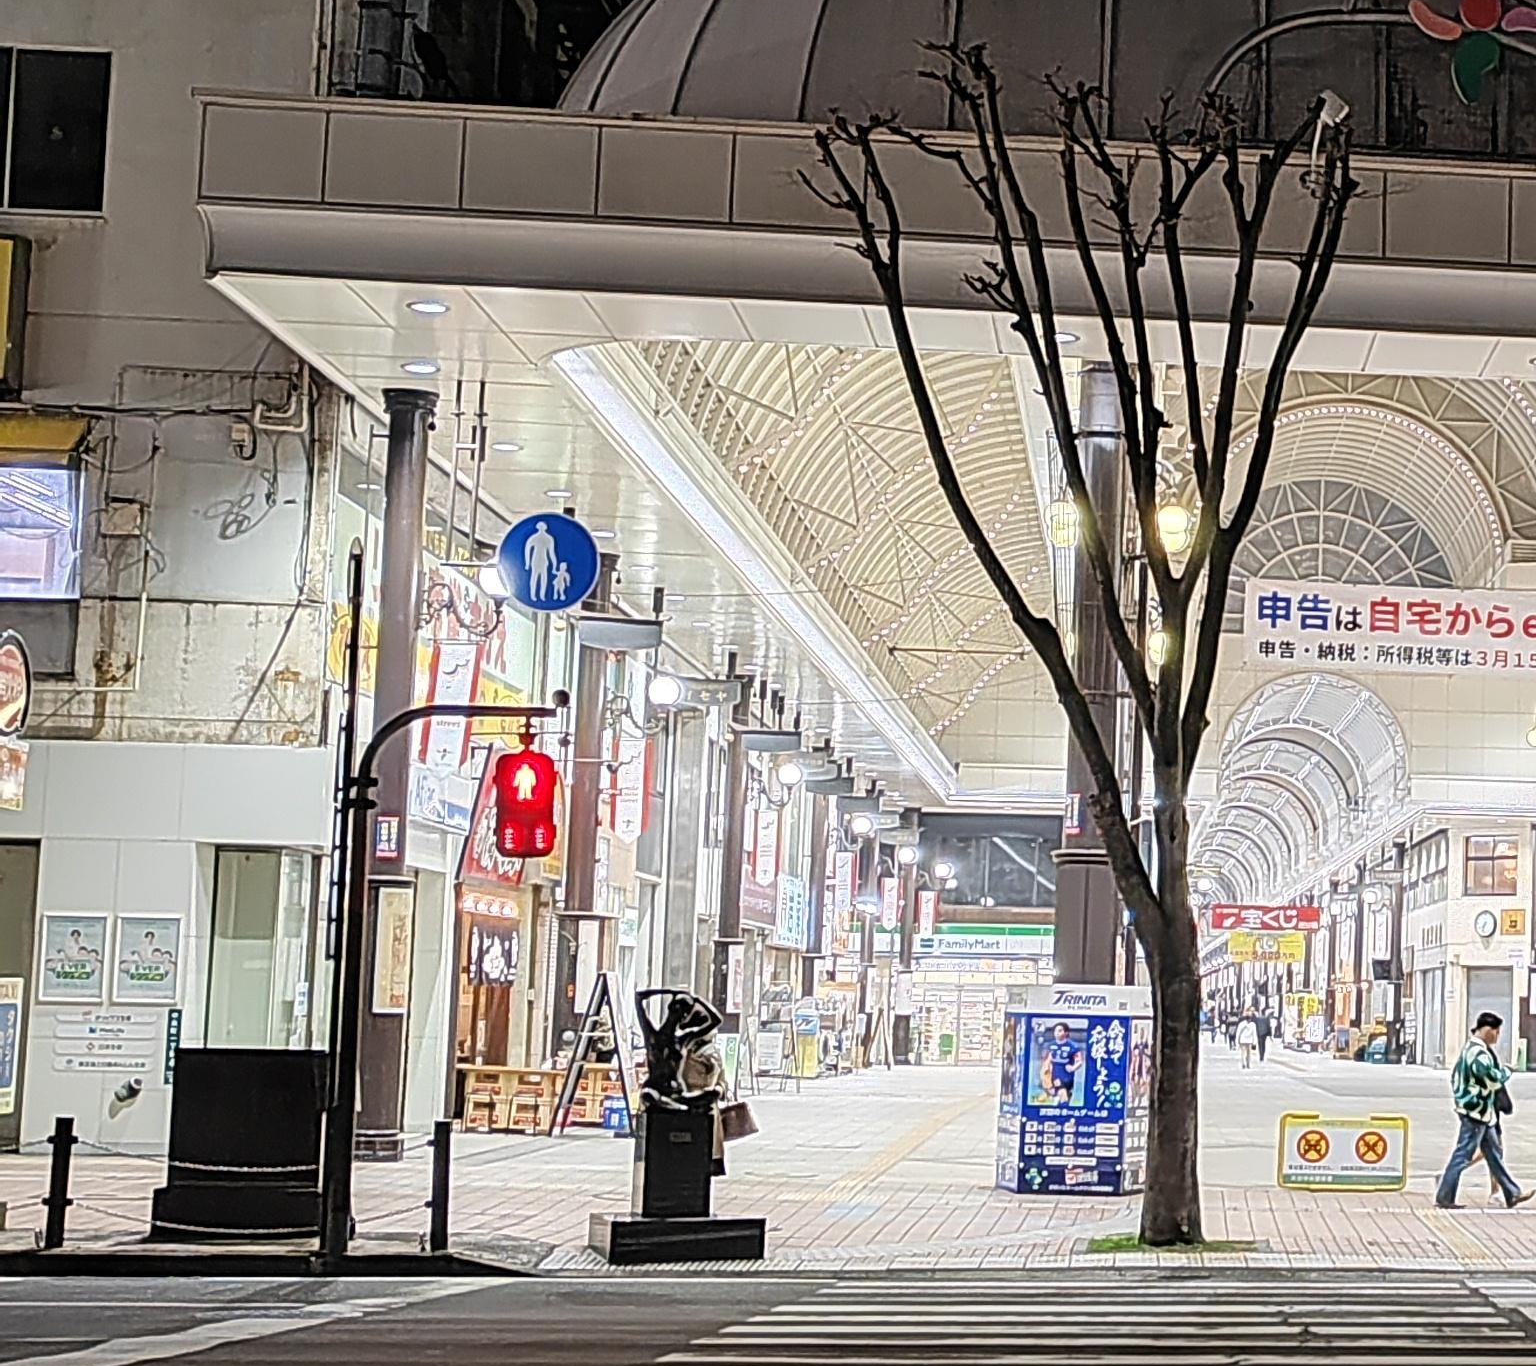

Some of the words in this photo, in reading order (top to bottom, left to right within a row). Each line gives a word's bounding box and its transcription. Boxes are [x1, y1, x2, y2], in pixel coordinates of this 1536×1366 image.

[1241, 909, 1298, 928] 宝くじ
[938, 938, 1001, 950] FamilyMart
[1052, 990, 1107, 1007] TRINITA
